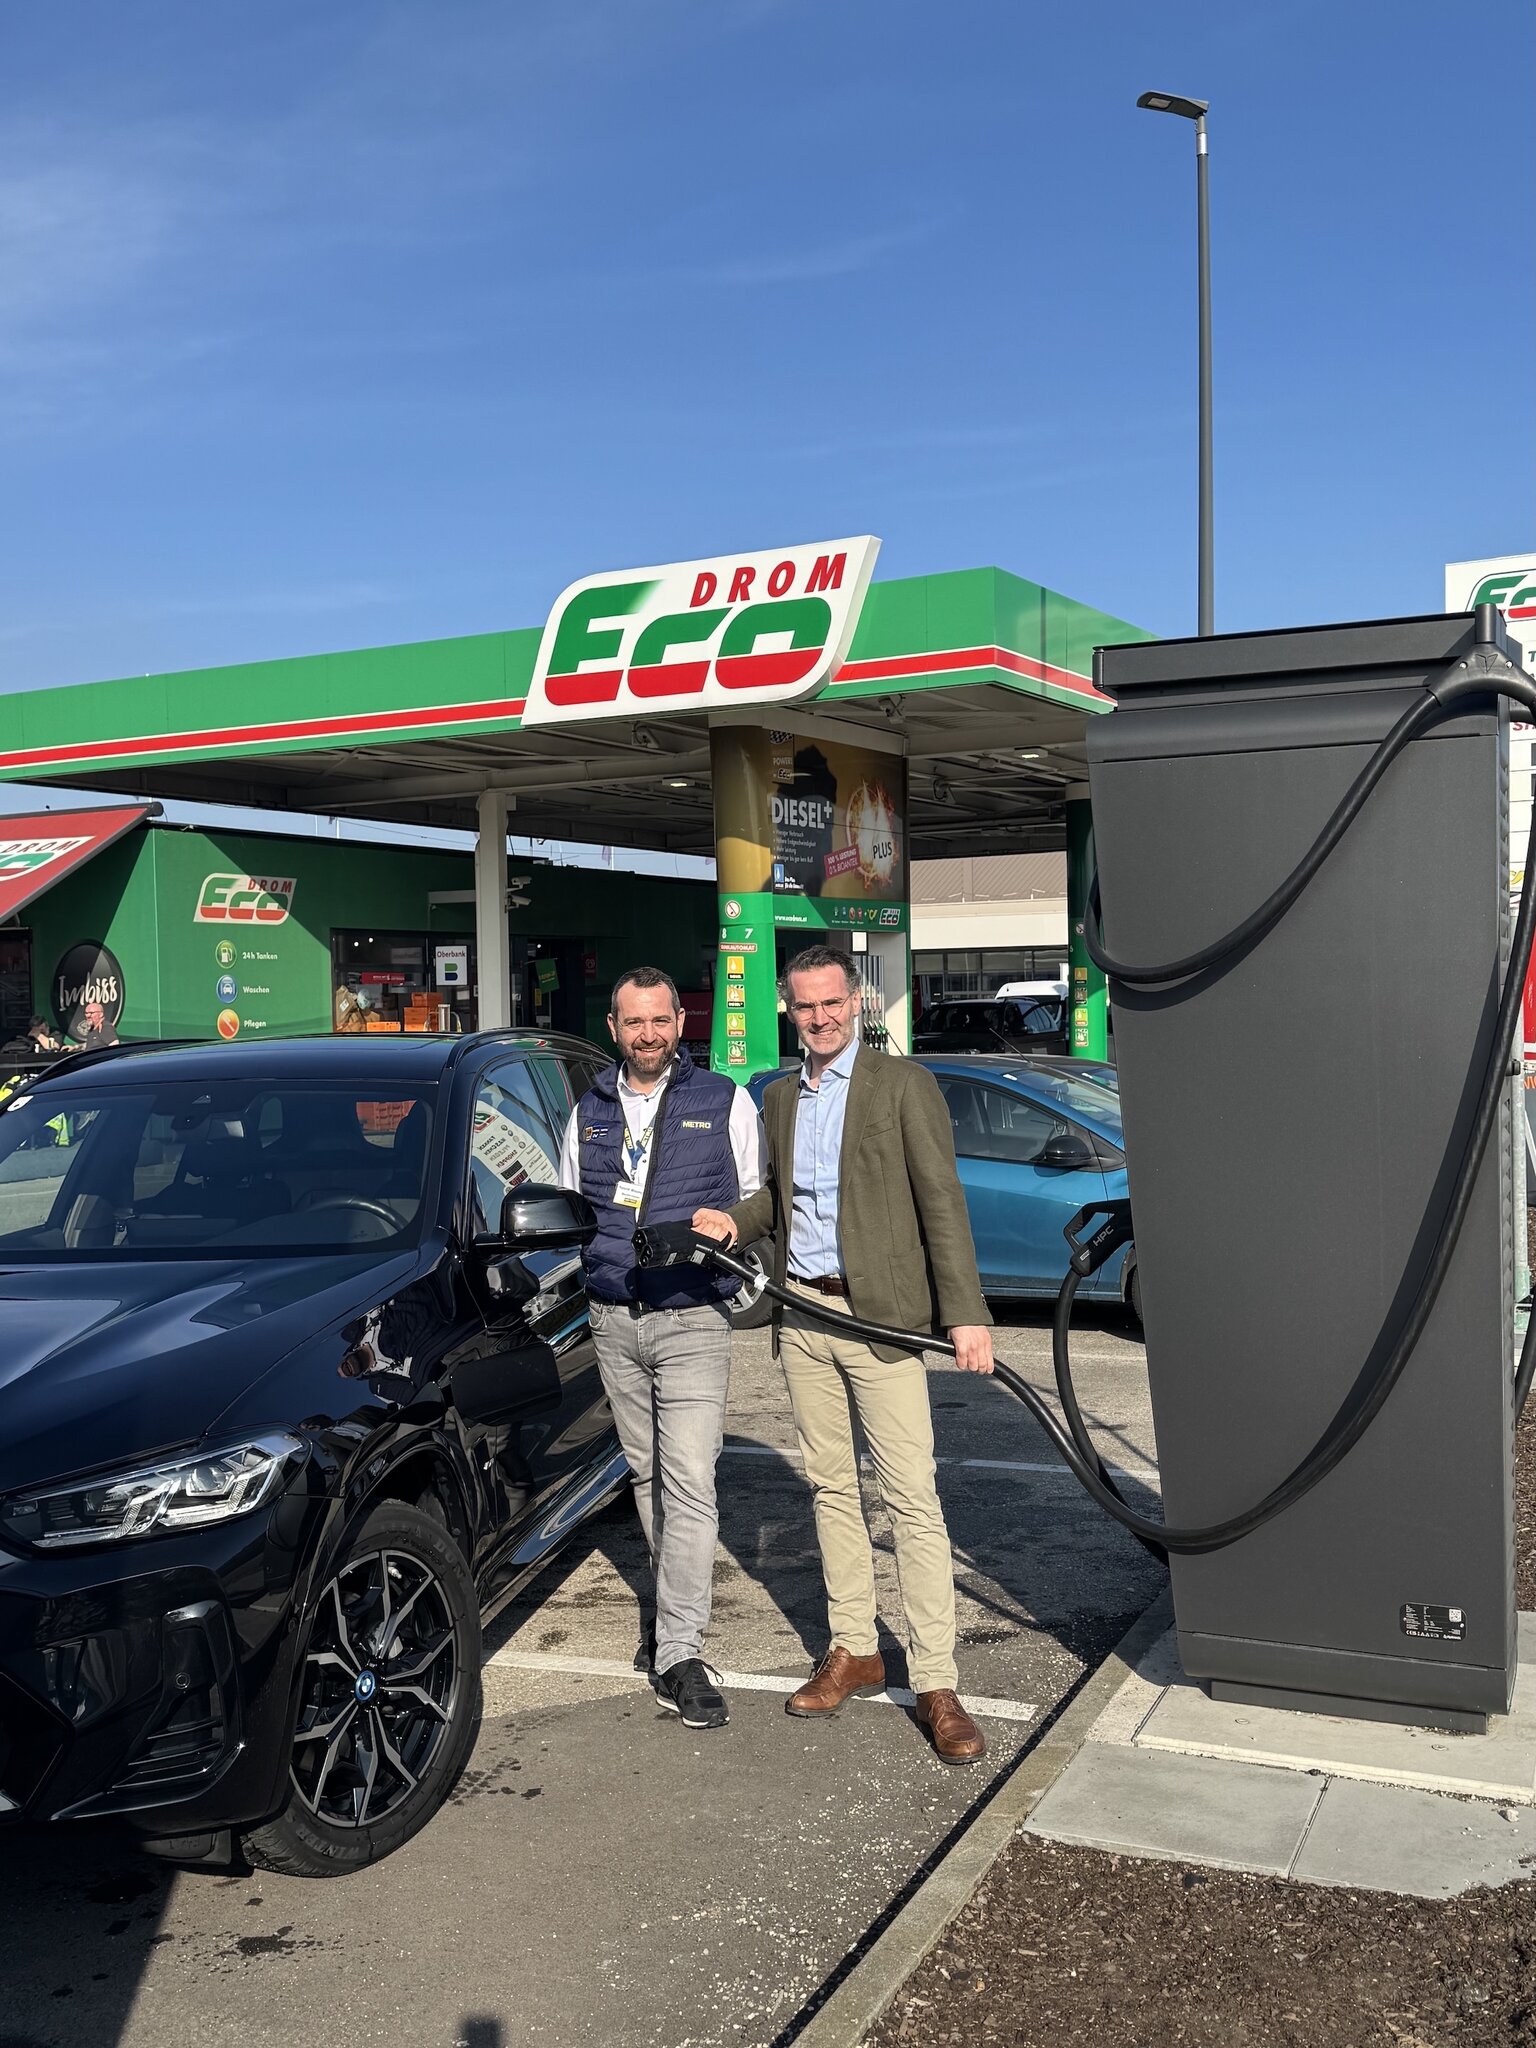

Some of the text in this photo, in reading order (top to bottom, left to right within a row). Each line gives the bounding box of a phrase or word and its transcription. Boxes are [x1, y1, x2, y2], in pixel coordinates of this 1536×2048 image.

[689, 552, 848, 608] DROM
[873, 841, 893, 859] PLUS
[248, 879, 292, 893] DROM
[721, 928, 753, 939] 8 7
[256, 952, 278, 960] Tanken
[243, 1020, 267, 1029] Pflegen
[682, 1120, 711, 1129] METRO
[1092, 1225, 1114, 1247] HPC
